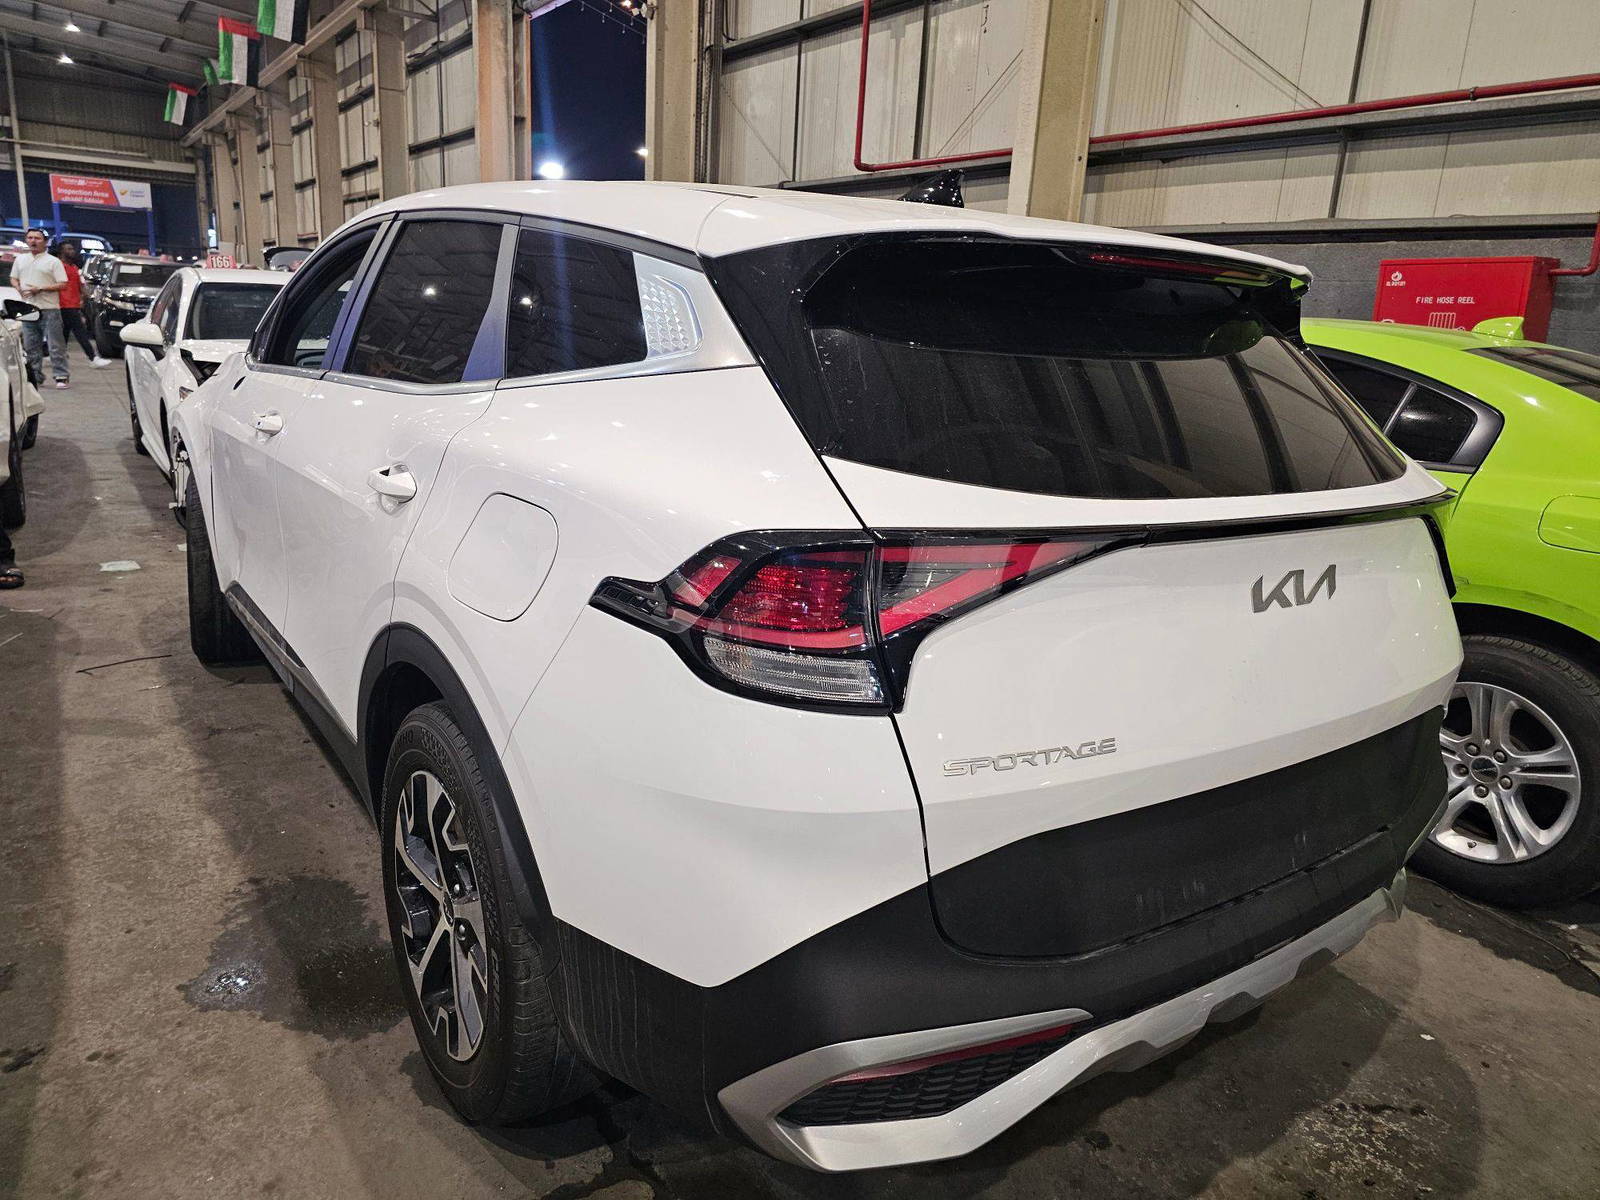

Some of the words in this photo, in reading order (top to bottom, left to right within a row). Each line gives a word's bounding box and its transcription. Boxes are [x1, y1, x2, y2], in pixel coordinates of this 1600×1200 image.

[1415, 296, 1433, 304] FIRE
[1436, 296, 1455, 304] HOSE
[1457, 296, 1475, 304] REEL
[1251, 564, 1336, 614] KIA
[943, 737, 1117, 777] SPORTAGE
